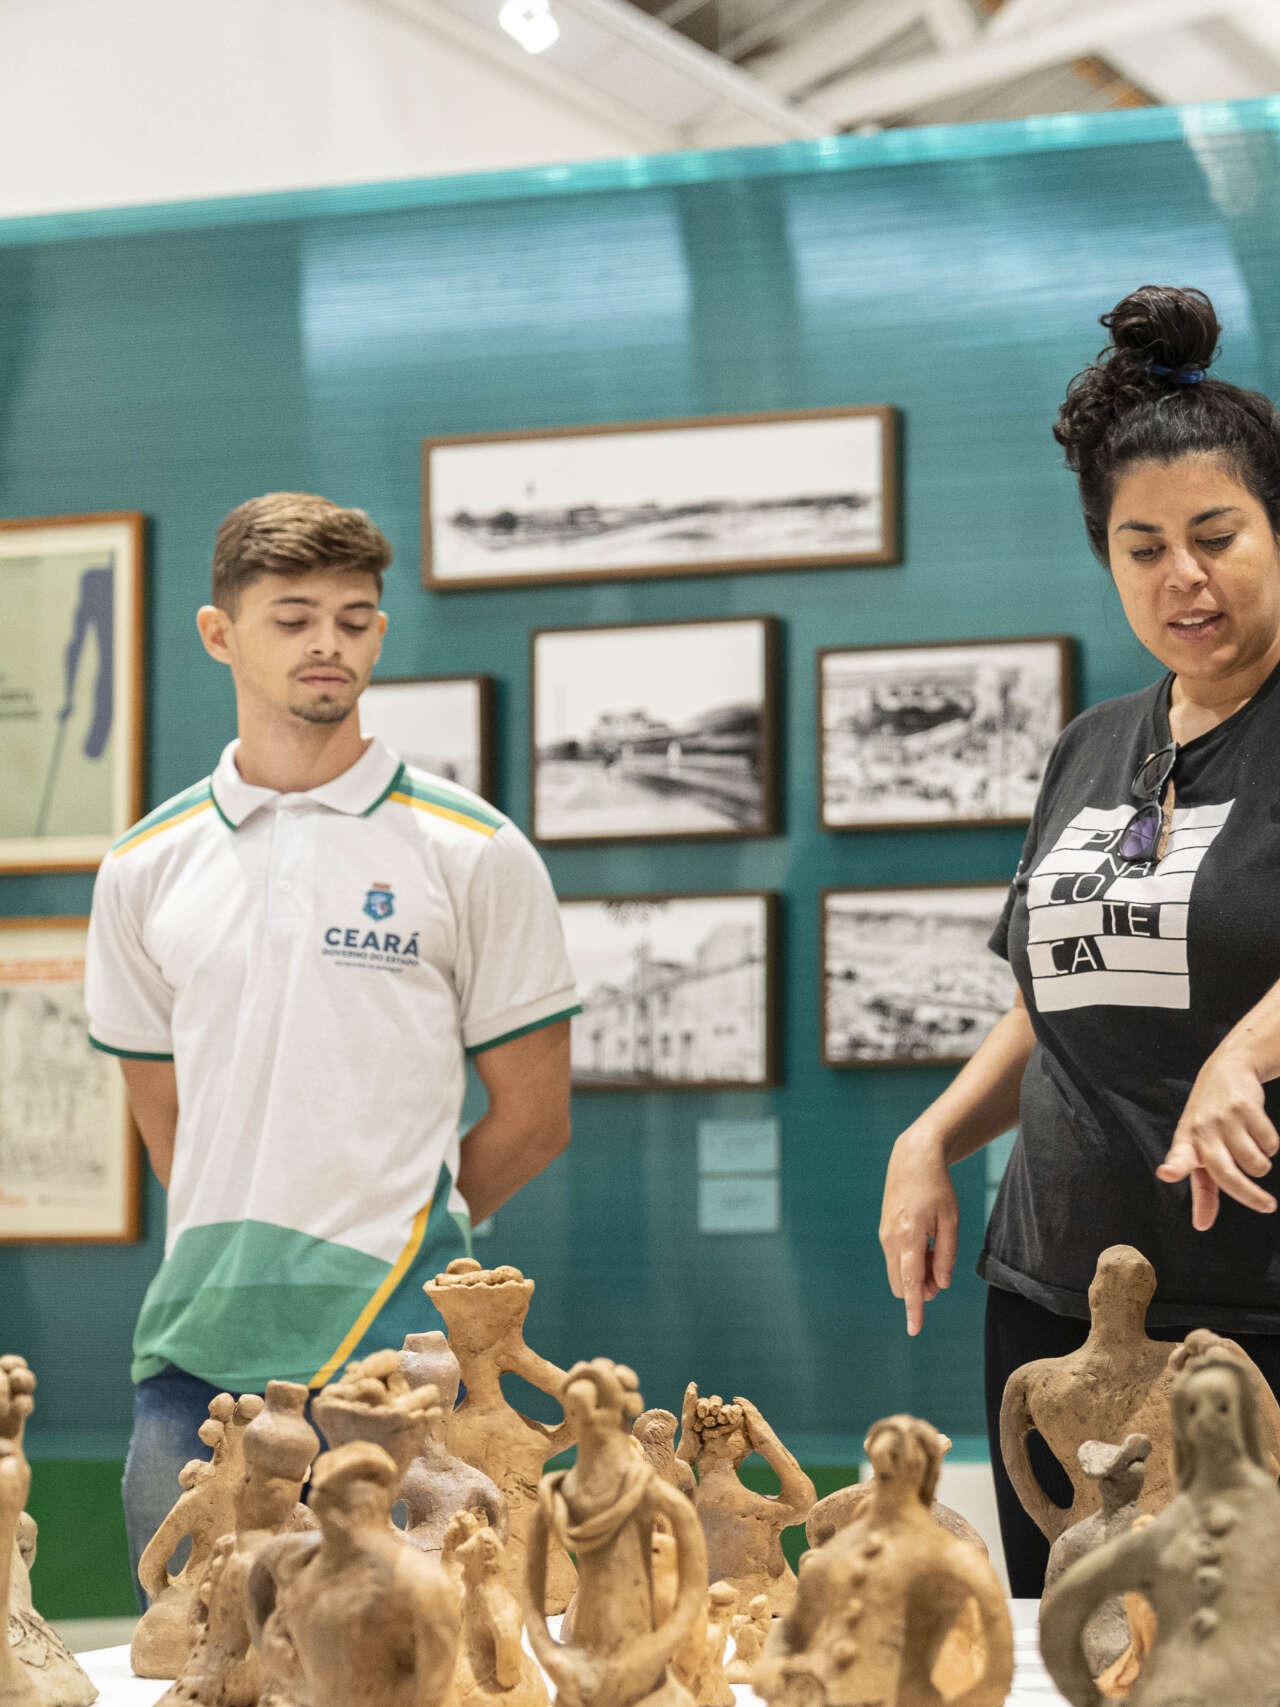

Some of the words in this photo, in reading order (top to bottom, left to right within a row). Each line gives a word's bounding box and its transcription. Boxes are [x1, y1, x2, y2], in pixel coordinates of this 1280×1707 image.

[1049, 873, 1106, 904] CO
[1101, 901, 1152, 937] TE
[324, 927, 419, 957] CEARÁ
[1050, 938, 1098, 974] CA
